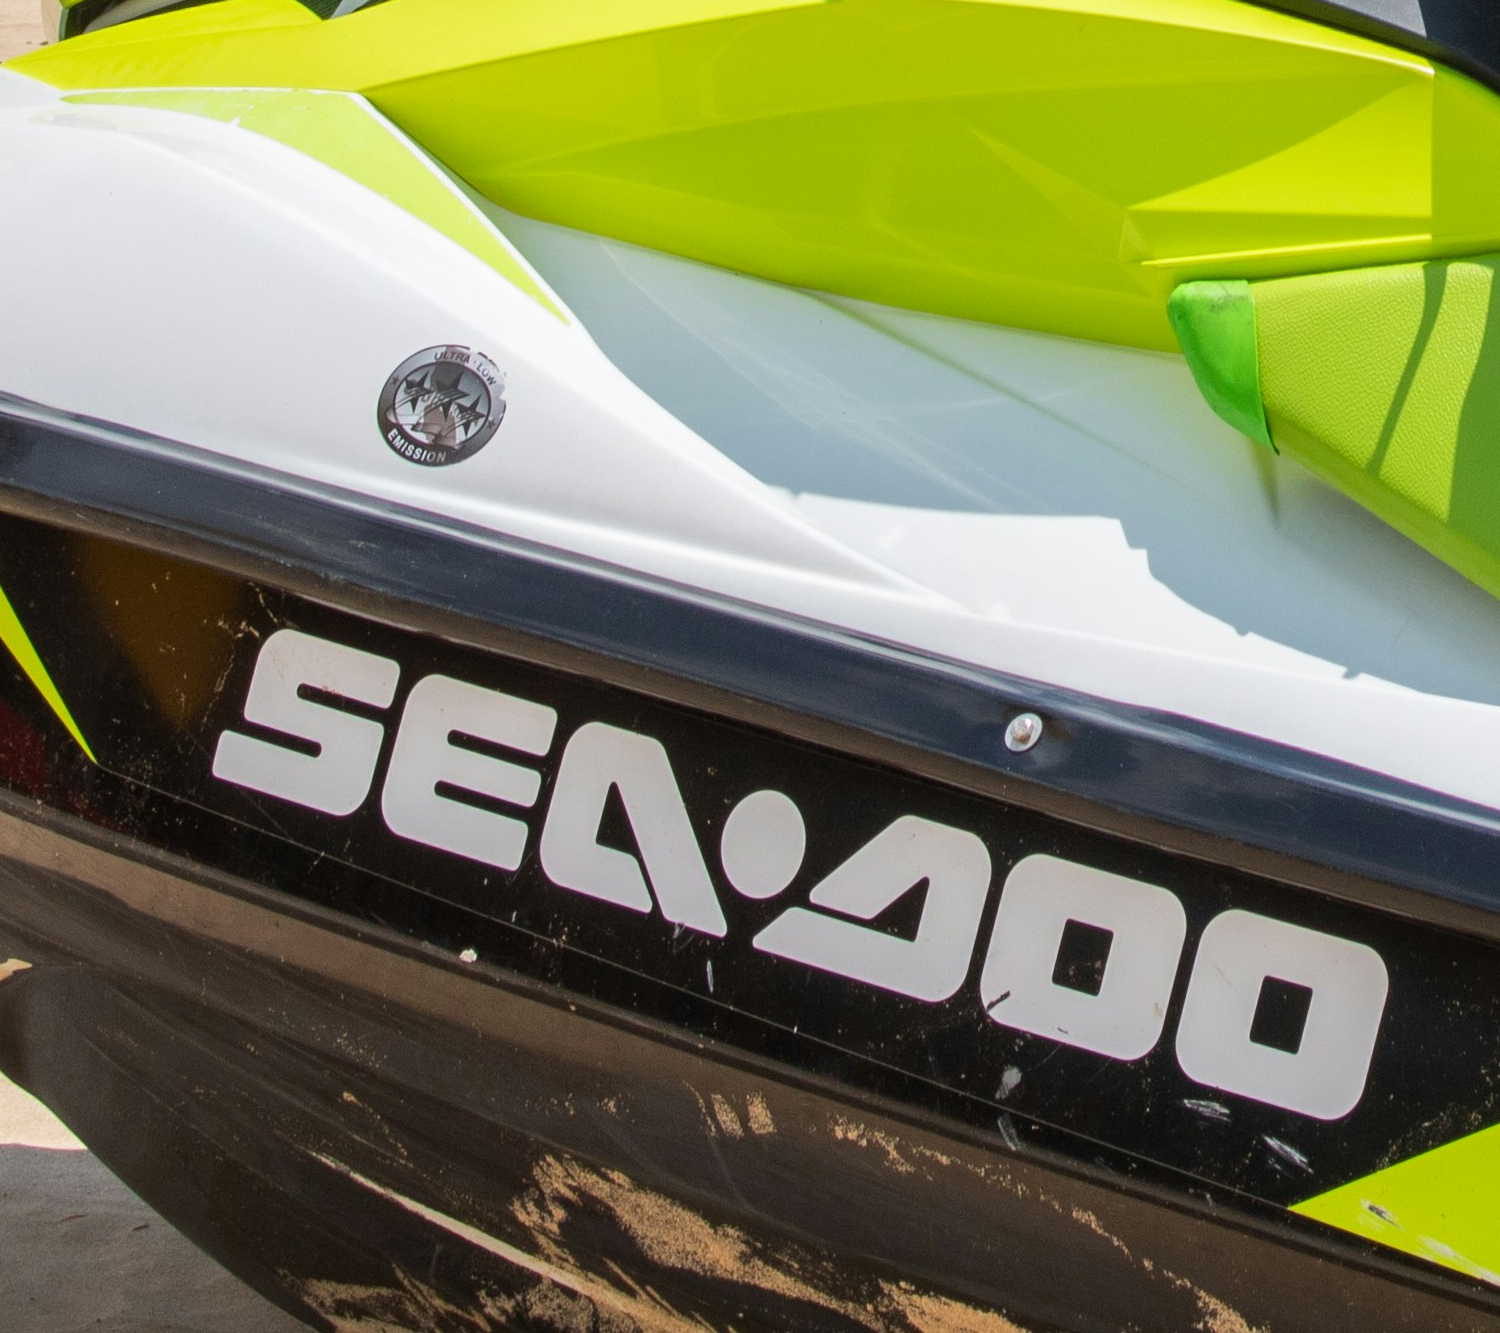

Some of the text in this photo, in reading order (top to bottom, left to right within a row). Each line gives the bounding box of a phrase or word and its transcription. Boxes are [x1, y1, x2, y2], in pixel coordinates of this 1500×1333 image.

[434, 351, 497, 387] ULTRA LOW
[387, 427, 448, 463] EMISSION
